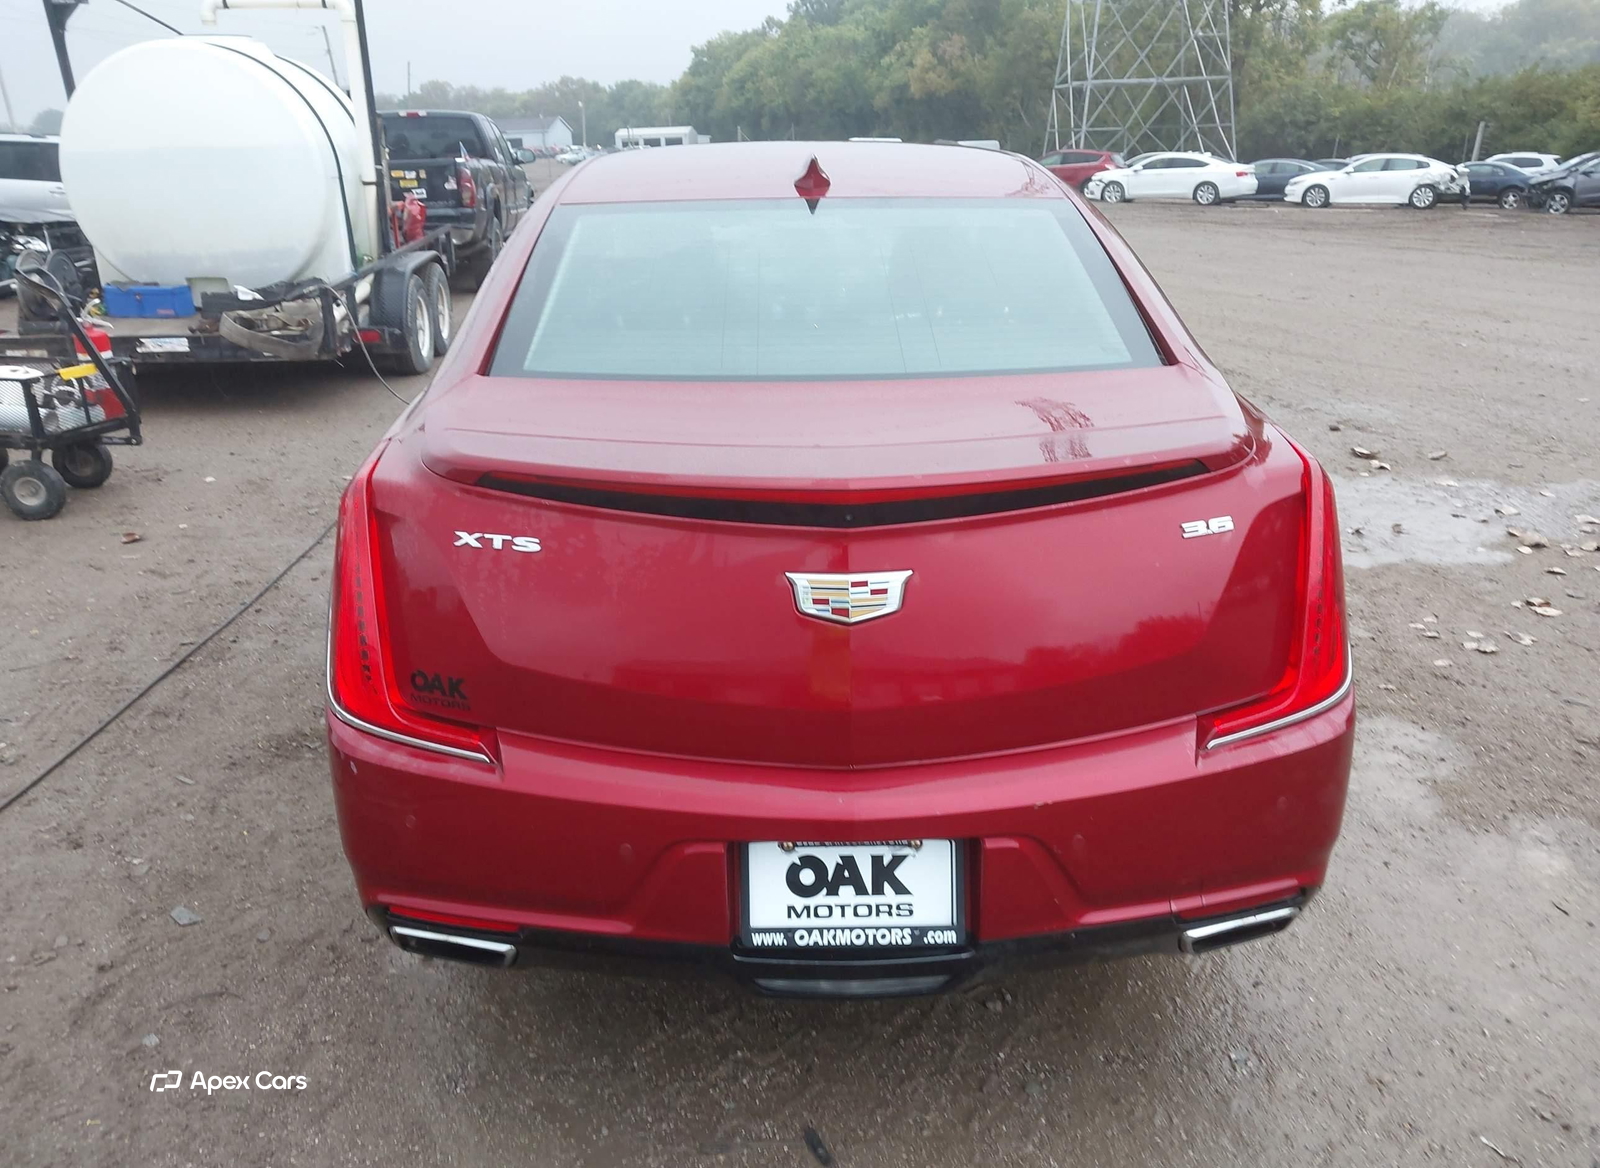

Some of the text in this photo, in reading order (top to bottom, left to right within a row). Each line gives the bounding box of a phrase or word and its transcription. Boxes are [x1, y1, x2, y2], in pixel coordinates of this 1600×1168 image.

[1180, 515, 1235, 539] 3.6
[453, 530, 542, 553] XTS
[410, 668, 468, 700] OAK
[410, 693, 471, 711] MOTORS
[785, 854, 913, 898] OAK
[786, 903, 914, 919] MOTORS
[751, 927, 957, 946] www. OAKMOTORS .com
